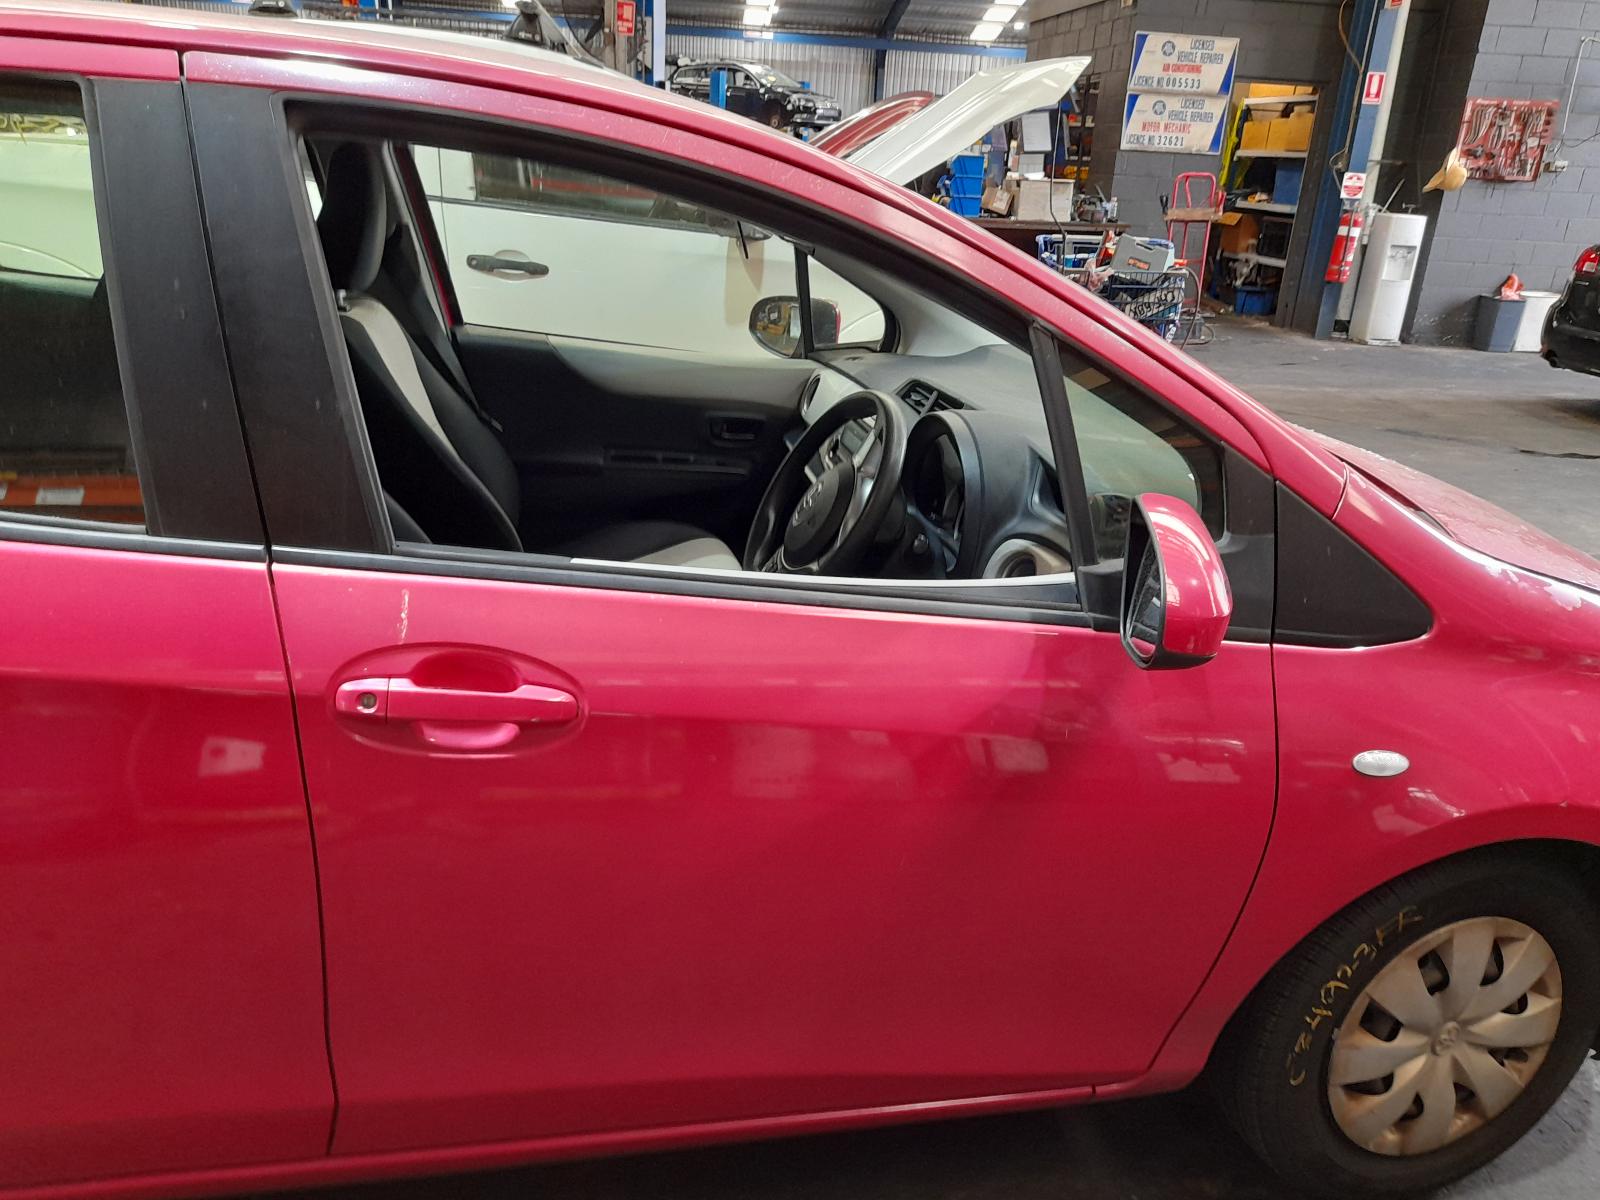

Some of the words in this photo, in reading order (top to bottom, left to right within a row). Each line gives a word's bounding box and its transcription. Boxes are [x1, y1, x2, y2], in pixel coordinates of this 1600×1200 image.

[1190, 38, 1215, 51] LICENSED
[1177, 51, 1198, 63] VEHICLE
[1199, 52, 1224, 64] REPAIRER
[1133, 75, 1154, 87] LICENCE
[1165, 76, 1201, 89] 005533
[1180, 98, 1206, 109] LICENSED
[1167, 110, 1188, 122] VEHICLE
[1190, 111, 1214, 122] REPAIRER
[1141, 122, 1160, 132] MOTOR
[1163, 122, 1192, 134] MECHANIC
[1125, 133, 1146, 145] LICENCE
[1156, 135, 1184, 147] 32621
